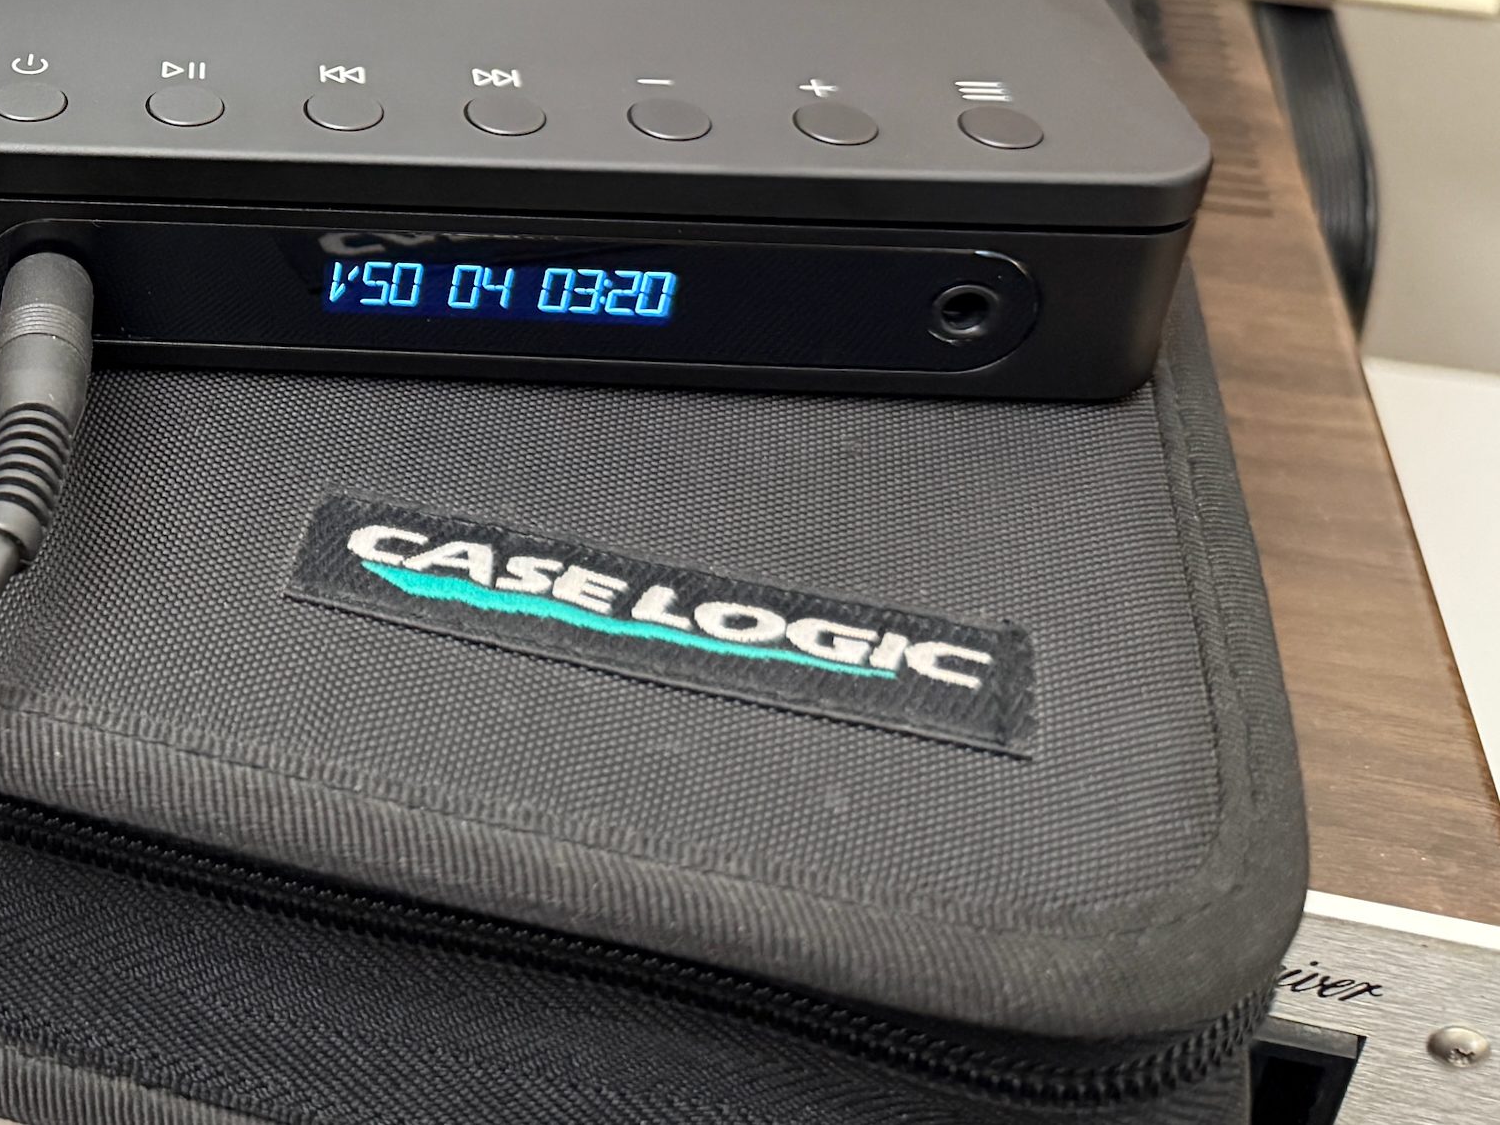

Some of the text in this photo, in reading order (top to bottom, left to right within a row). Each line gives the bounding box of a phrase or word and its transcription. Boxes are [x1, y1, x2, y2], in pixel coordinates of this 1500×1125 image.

[447, 264, 515, 310] 04
[537, 267, 677, 318] 03:20
[347, 524, 994, 690] CASE LOGIC
